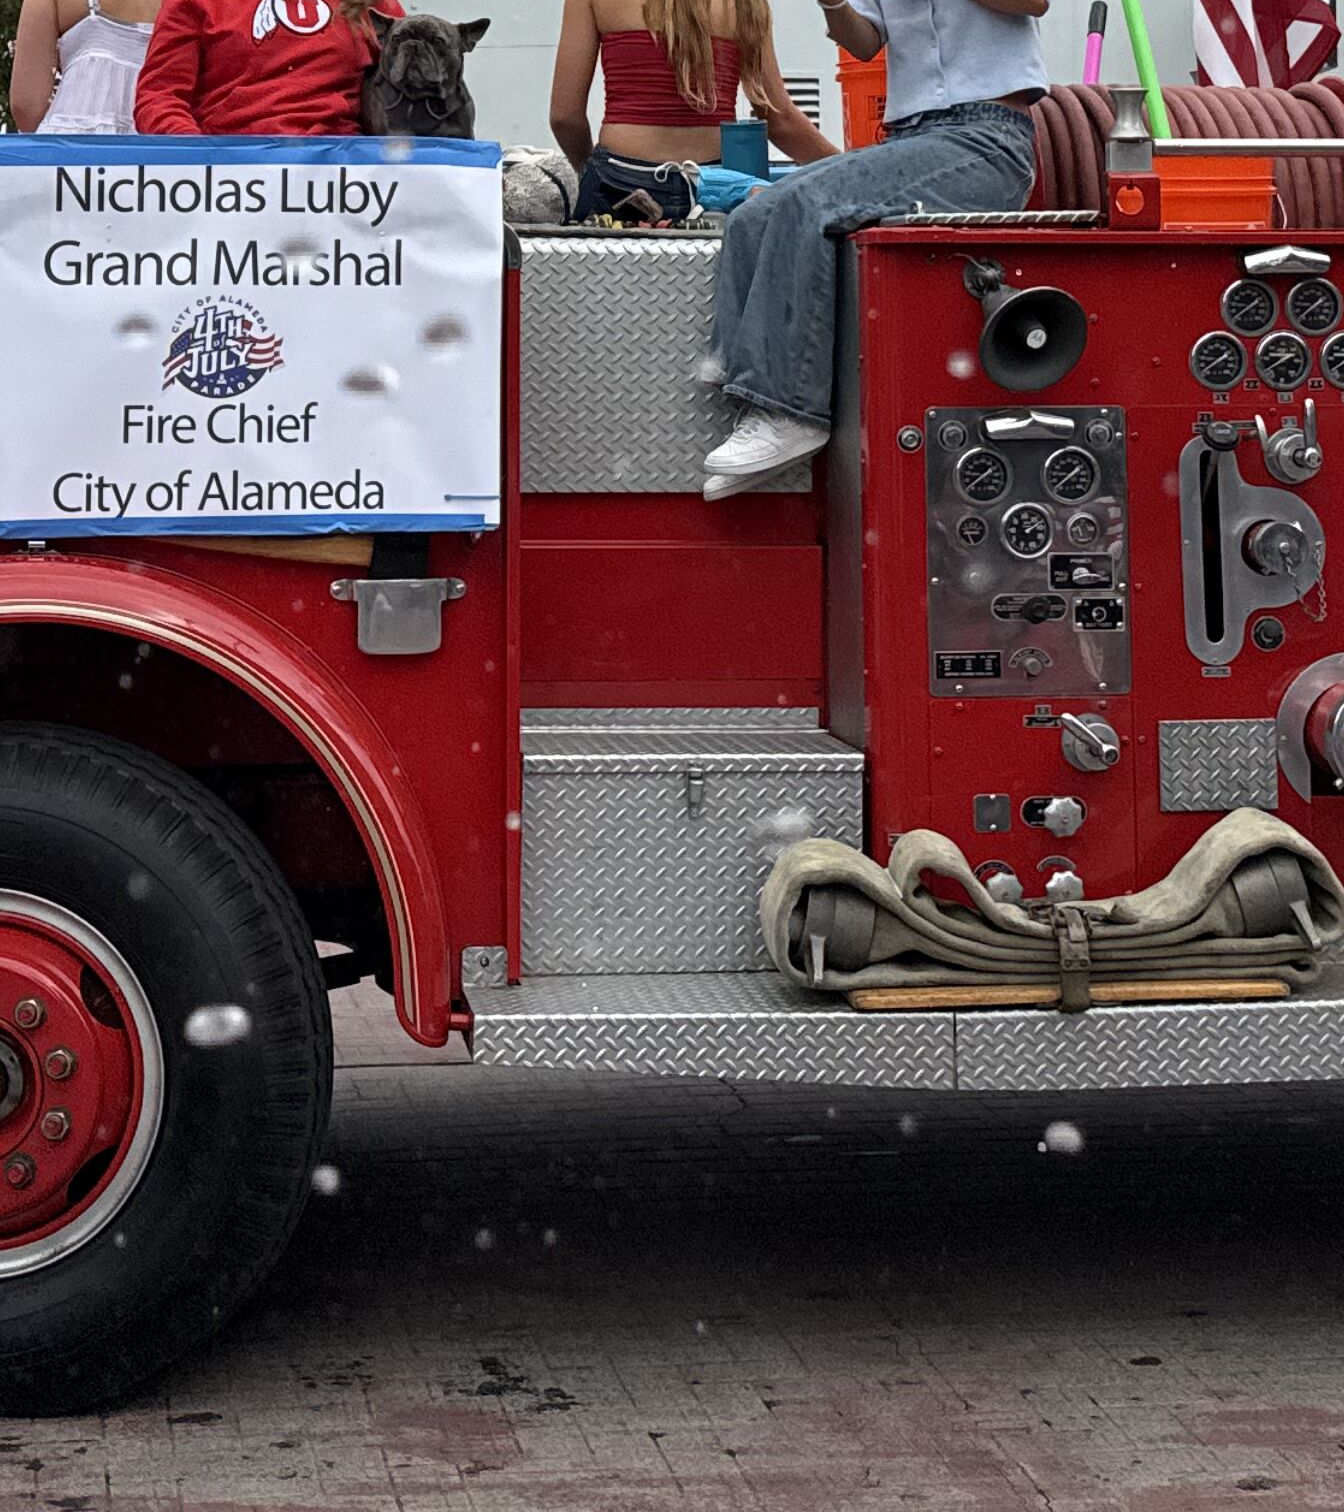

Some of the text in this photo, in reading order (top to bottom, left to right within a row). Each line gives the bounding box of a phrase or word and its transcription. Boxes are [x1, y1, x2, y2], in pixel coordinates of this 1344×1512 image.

[54, 166, 399, 227] Nicholas Luby
[43, 237, 403, 287] Grand Marshal
[171, 294, 269, 334] CITY OF ALAMEDA
[194, 306, 245, 352] 4TH
[183, 343, 254, 379] JULY
[122, 401, 319, 445] Fire Chief
[51, 468, 386, 518] City of Alameda
